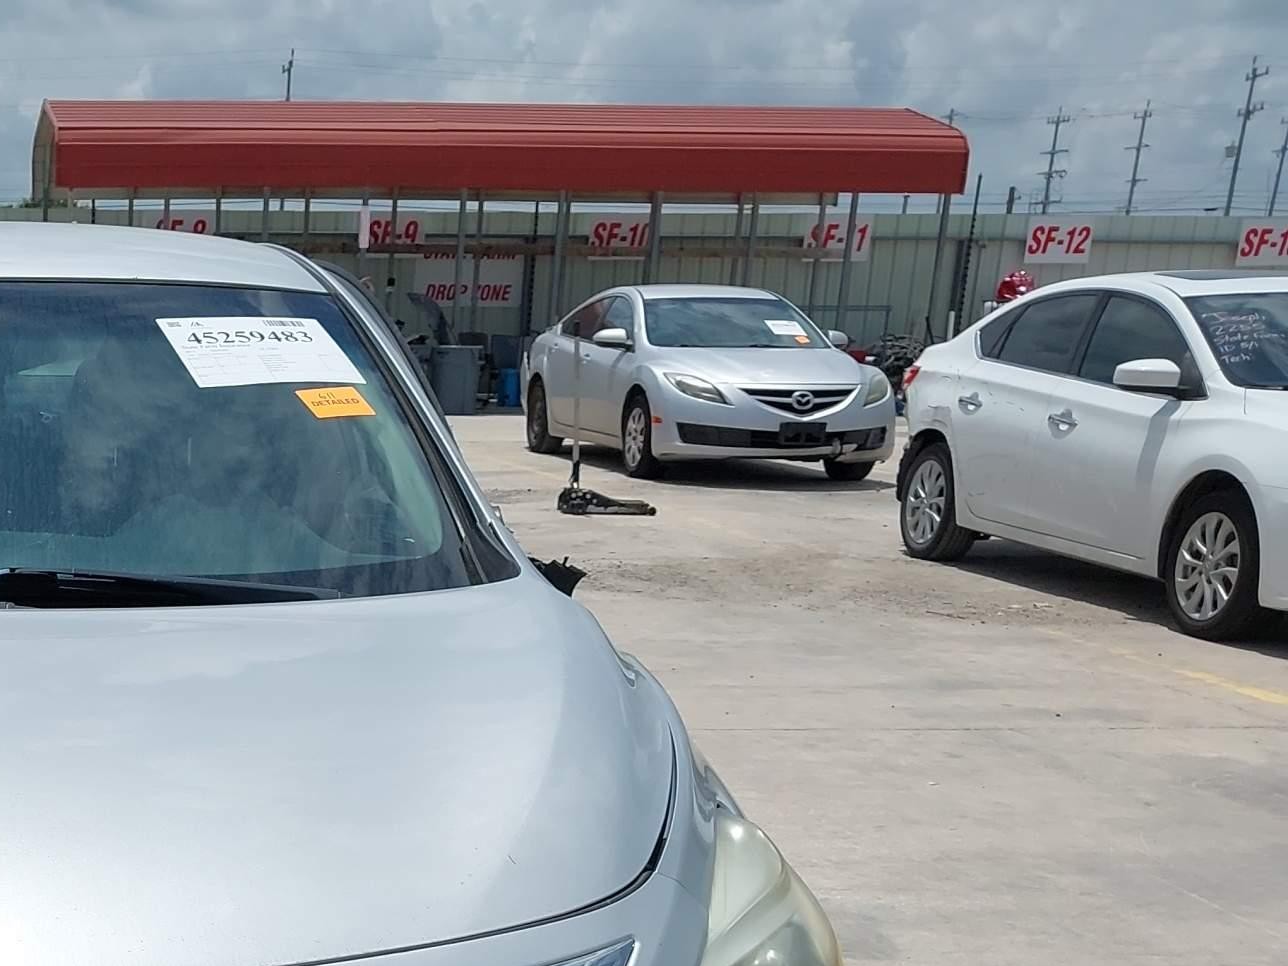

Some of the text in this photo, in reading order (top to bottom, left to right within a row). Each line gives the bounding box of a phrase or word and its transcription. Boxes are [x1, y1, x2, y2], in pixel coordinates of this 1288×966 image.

[369, 220, 419, 245] SF-9
[808, 223, 869, 252] SF-1
[1027, 226, 1092, 254] SF-12
[1240, 228, 1288, 257] SF-1
[478, 284, 512, 301] ONE
[187, 330, 313, 344] 45259483
